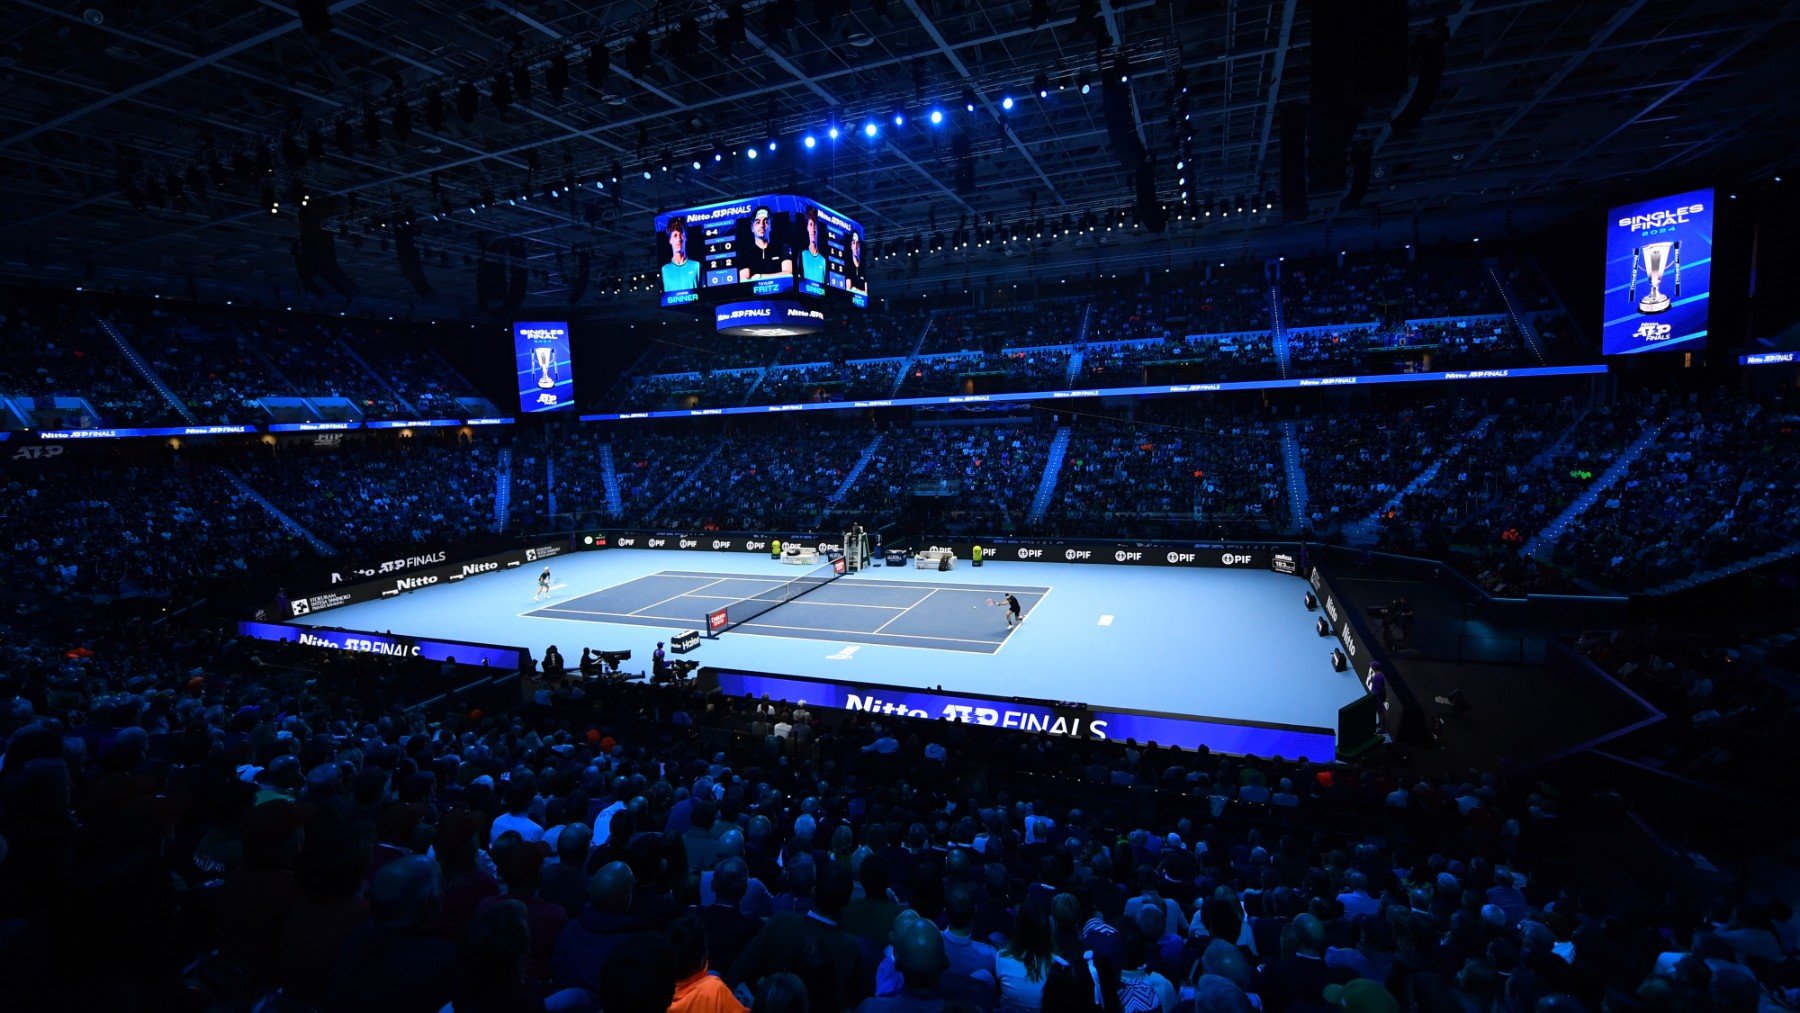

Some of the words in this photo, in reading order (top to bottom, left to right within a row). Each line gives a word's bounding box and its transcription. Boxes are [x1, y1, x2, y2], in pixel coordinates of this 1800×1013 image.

[686, 214, 710, 222] Nitto
[727, 205, 752, 215] FINALS
[1618, 203, 1704, 227] SINGLES
[1630, 215, 1690, 232] FINAL
[1642, 226, 1676, 236] 2024
[754, 284, 779, 294] FRITZ
[667, 294, 698, 304] SINNER
[744, 309, 770, 318] FINALS
[1632, 324, 1671, 338] ATP
[1646, 333, 1671, 341] FINALS
[11, 445, 64, 460] ATP
[1028, 549, 1042, 558] PIF
[1076, 550, 1091, 559] PIF
[1126, 552, 1142, 561] PIF
[1179, 554, 1195, 562] PIF
[1234, 555, 1251, 564] PIF
[378, 559, 406, 574] ATP
[406, 551, 446, 568] FINALS
[462, 560, 498, 576] Nitto
[397, 575, 438, 590] Nitto
[1325, 595, 1338, 622] Nitto
[344, 638, 371, 652] ATP
[682, 636, 700, 650] Haier
[1341, 623, 1356, 656] Nitto
[935, 704, 998, 726] ATP
